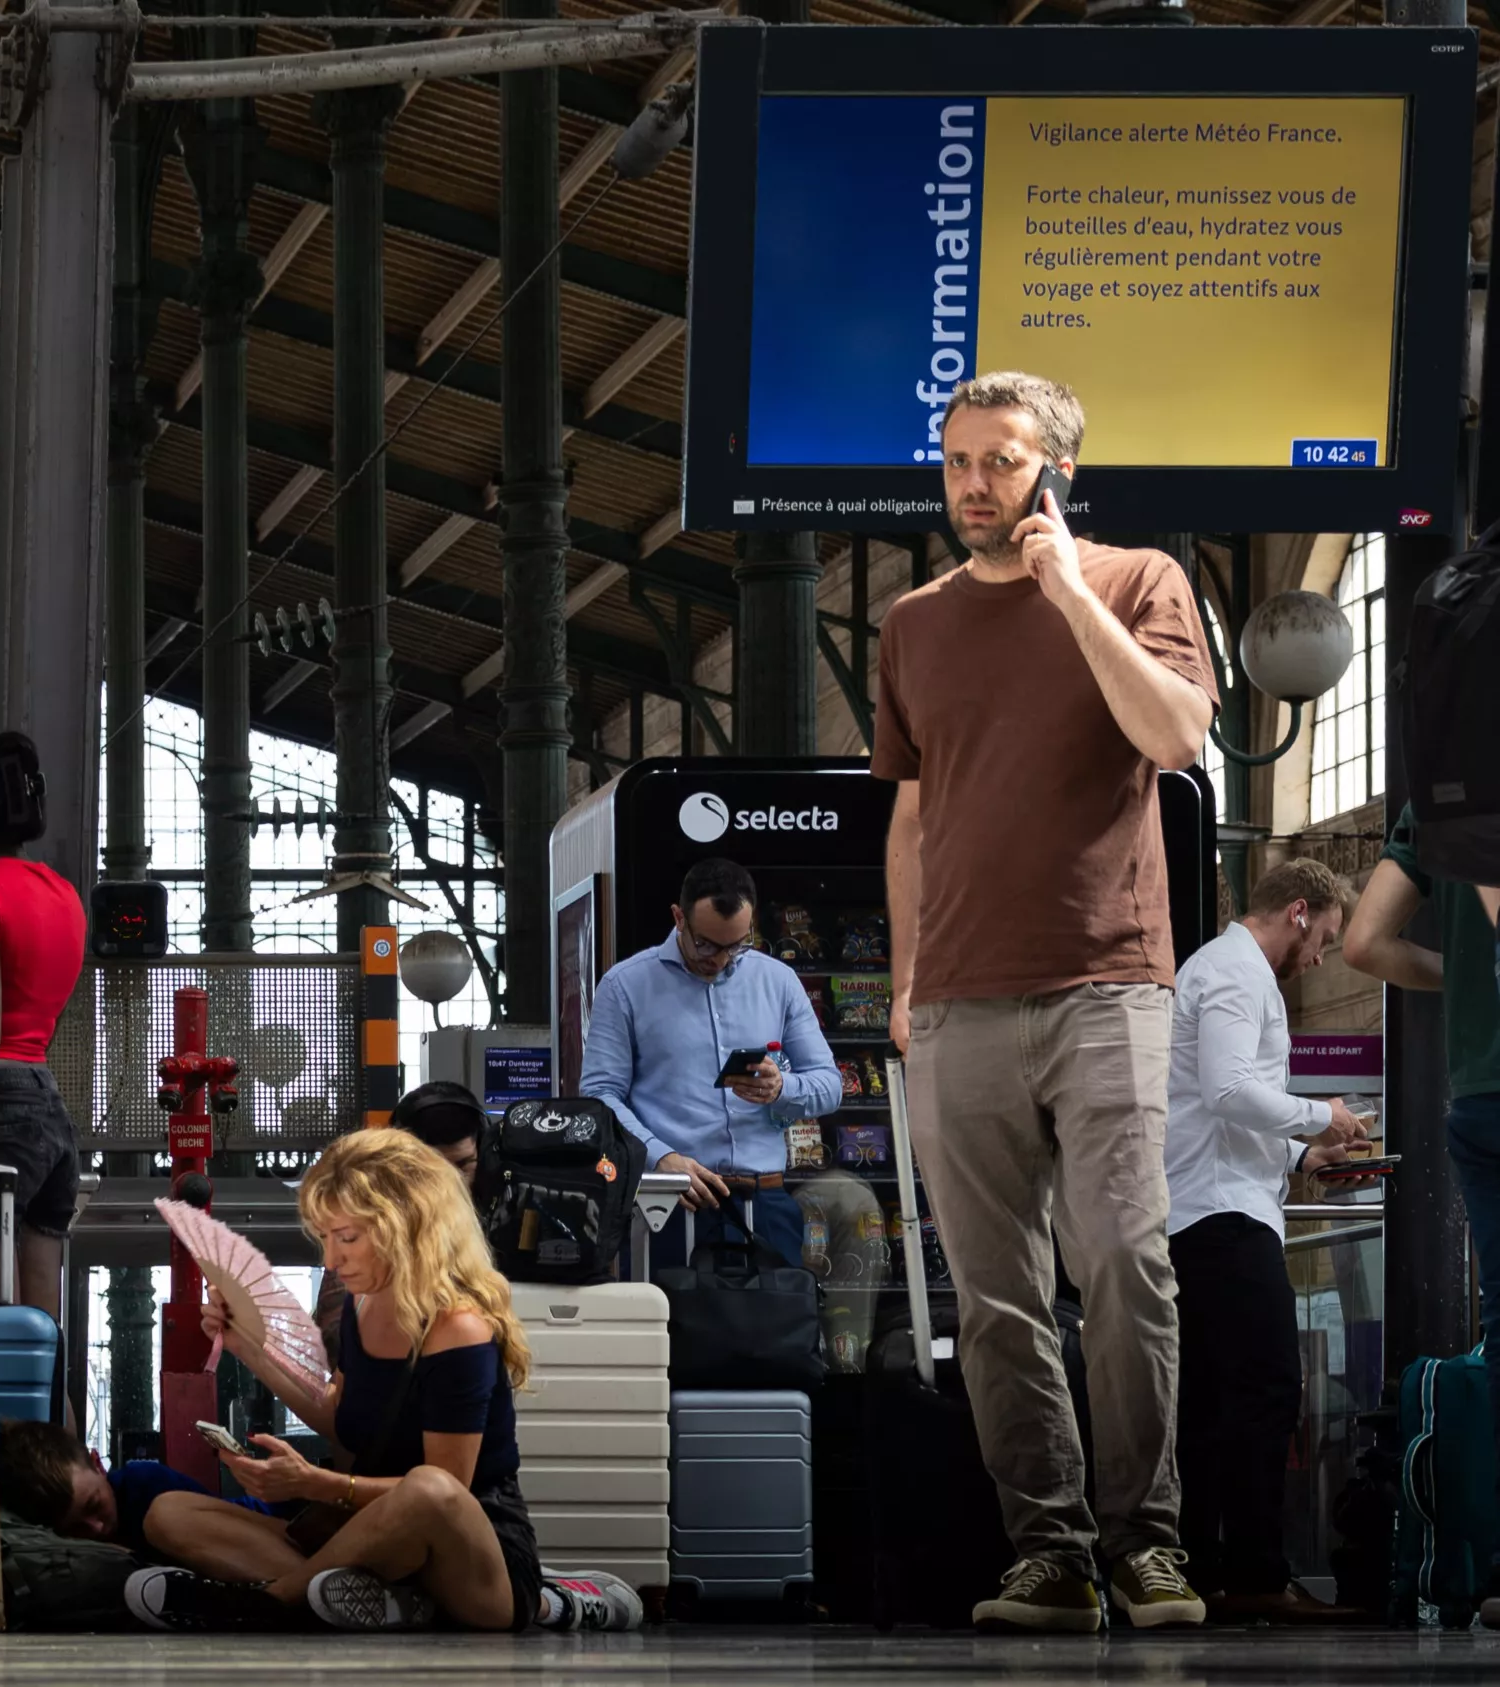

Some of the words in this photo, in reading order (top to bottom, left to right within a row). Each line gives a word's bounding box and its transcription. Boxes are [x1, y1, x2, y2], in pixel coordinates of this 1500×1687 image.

[1030, 123, 1122, 146] Vigilance
[1129, 124, 1188, 142] alerte
[1196, 124, 1260, 142] Météo
[1268, 124, 1342, 142] France.
[1028, 186, 1081, 204] Forte
[1089, 186, 1169, 208] chaleur,
[1177, 187, 1271, 205] munissez
[1278, 191, 1325, 205] vous
[1332, 186, 1357, 205] de
[1026, 216, 1127, 236] bouteilles
[1134, 217, 1194, 239] d'eau,
[1201, 217, 1289, 240] hydratez
[1296, 222, 1343, 236] vous
[1025, 248, 1168, 270] régulièrement
[1176, 248, 1260, 270] pendant
[1268, 250, 1321, 267] votre
[1023, 283, 1093, 302] voyage
[1100, 281, 1120, 297] et
[1127, 284, 1183, 302] soyez
[1189, 279, 1277, 298] attentifs
[1285, 284, 1320, 298] aux
[1021, 311, 1091, 328] autres.
[1304, 447, 1324, 463] 10
[1328, 447, 1349, 463] 42
[1352, 451, 1366, 463] 45
[762, 498, 822, 512] Présence
[825, 498, 834, 512] à
[837, 499, 866, 516] quai
[870, 499, 942, 515] obligatoire
[1062, 500, 1090, 514] part
[1400, 514, 1432, 525] SNCF
[733, 806, 839, 831] selecta
[840, 981, 885, 992] HARIBO
[1289, 1046, 1315, 1055] VANT
[1316, 1046, 1327, 1055] LE
[1329, 1045, 1363, 1056] DÉPART
[508, 1060, 543, 1069] Dunkerque
[171, 1124, 210, 1134] COLONNE
[177, 1138, 204, 1148] SECHE
